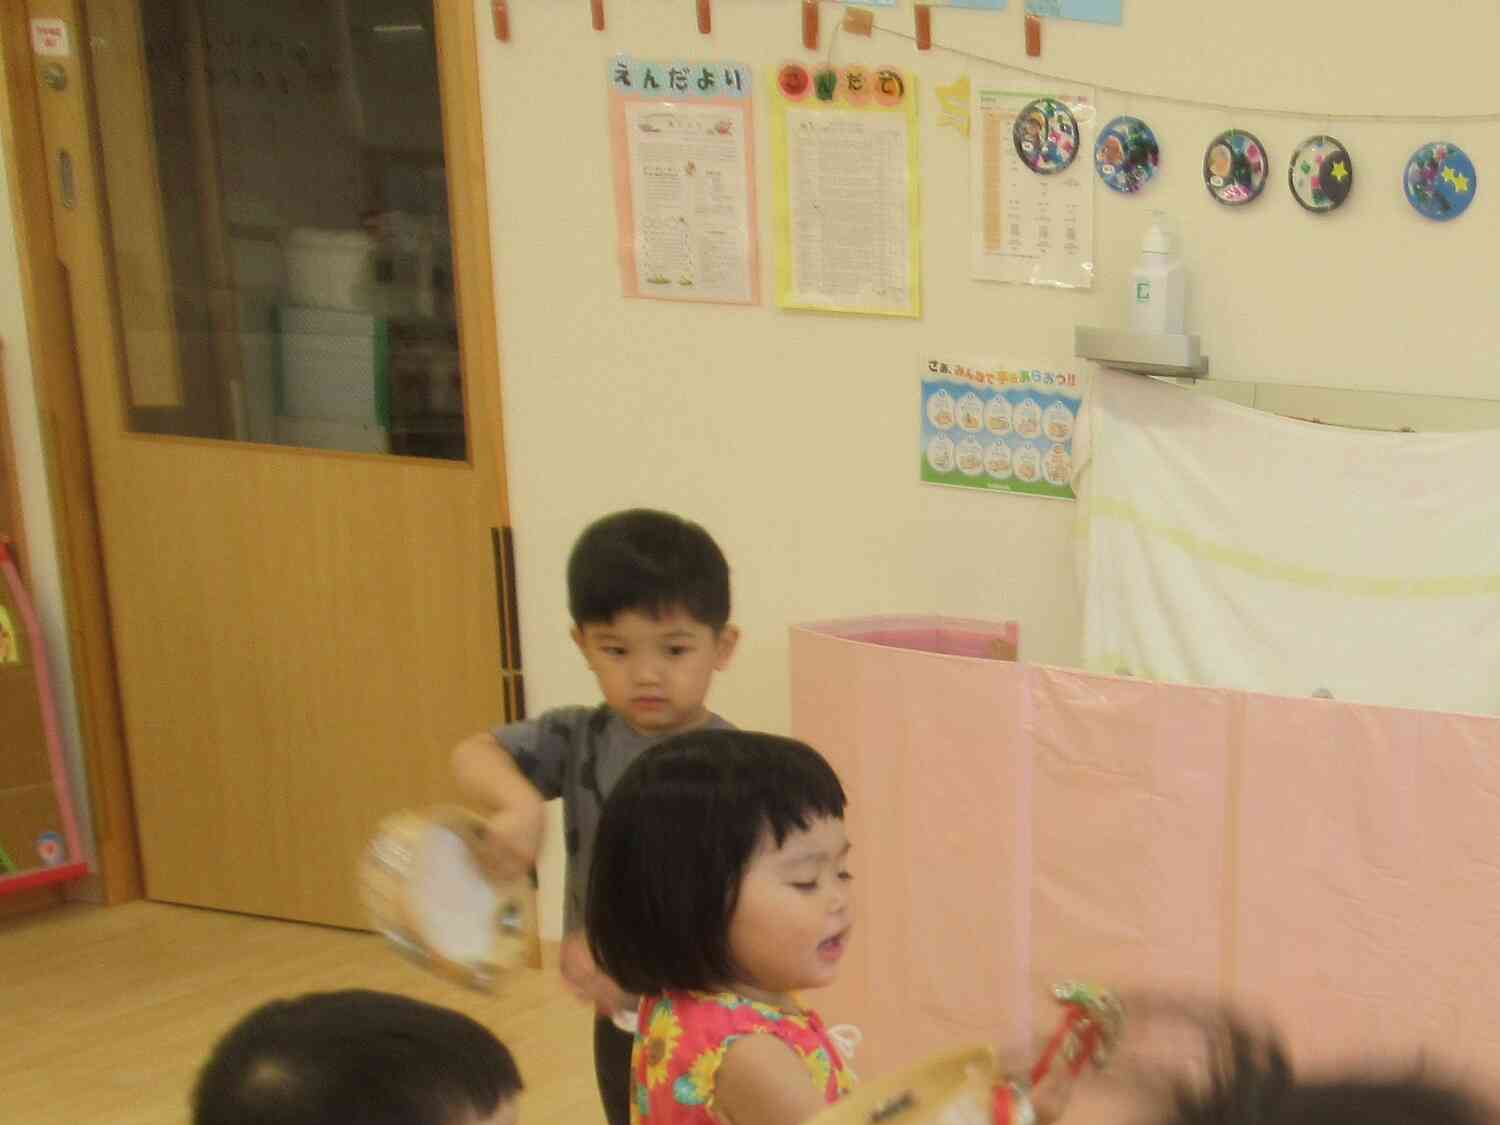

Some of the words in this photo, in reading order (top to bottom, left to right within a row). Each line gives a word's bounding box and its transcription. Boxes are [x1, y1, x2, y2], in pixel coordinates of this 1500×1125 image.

[613, 62, 742, 91] えんだより
